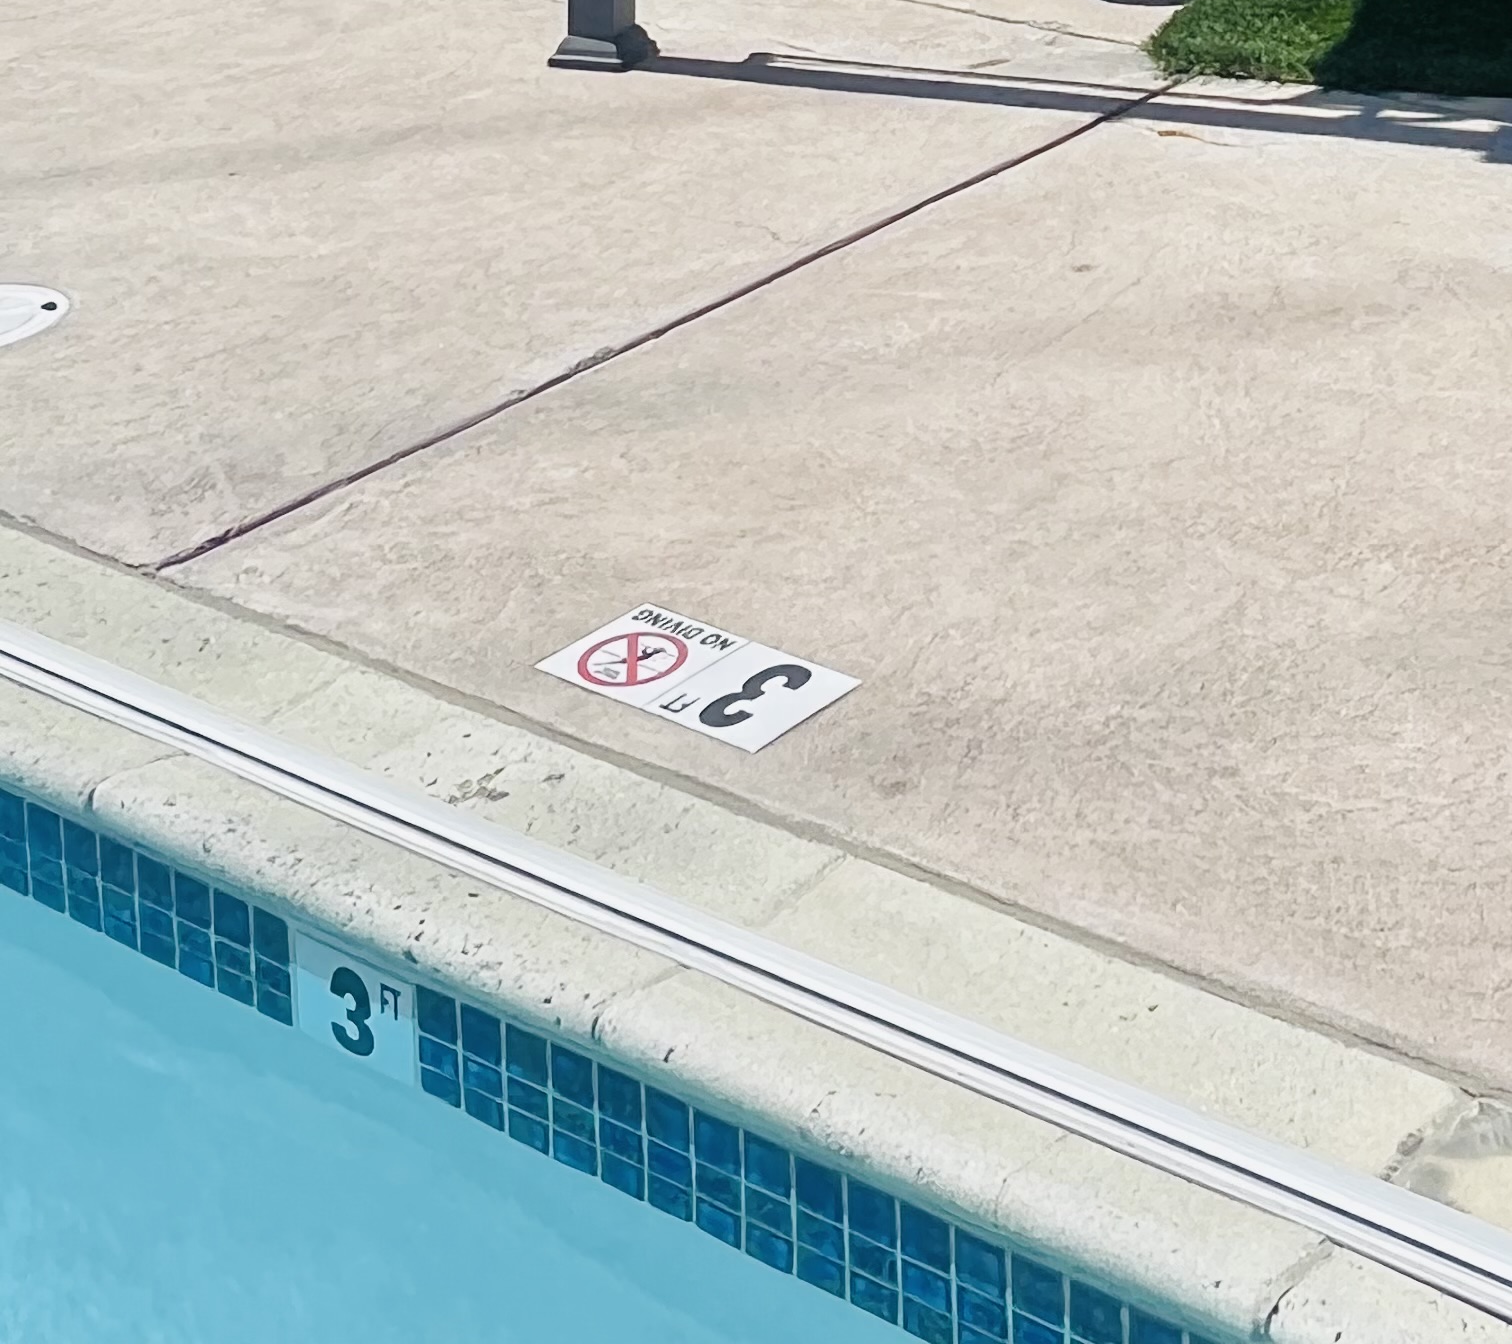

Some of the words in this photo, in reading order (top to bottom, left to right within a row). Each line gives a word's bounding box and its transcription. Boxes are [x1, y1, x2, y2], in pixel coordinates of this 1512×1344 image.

[631, 608, 702, 640] DIVING
[699, 633, 737, 651] NO
[330, 966, 374, 1056] 3
[380, 983, 401, 1020] FT
